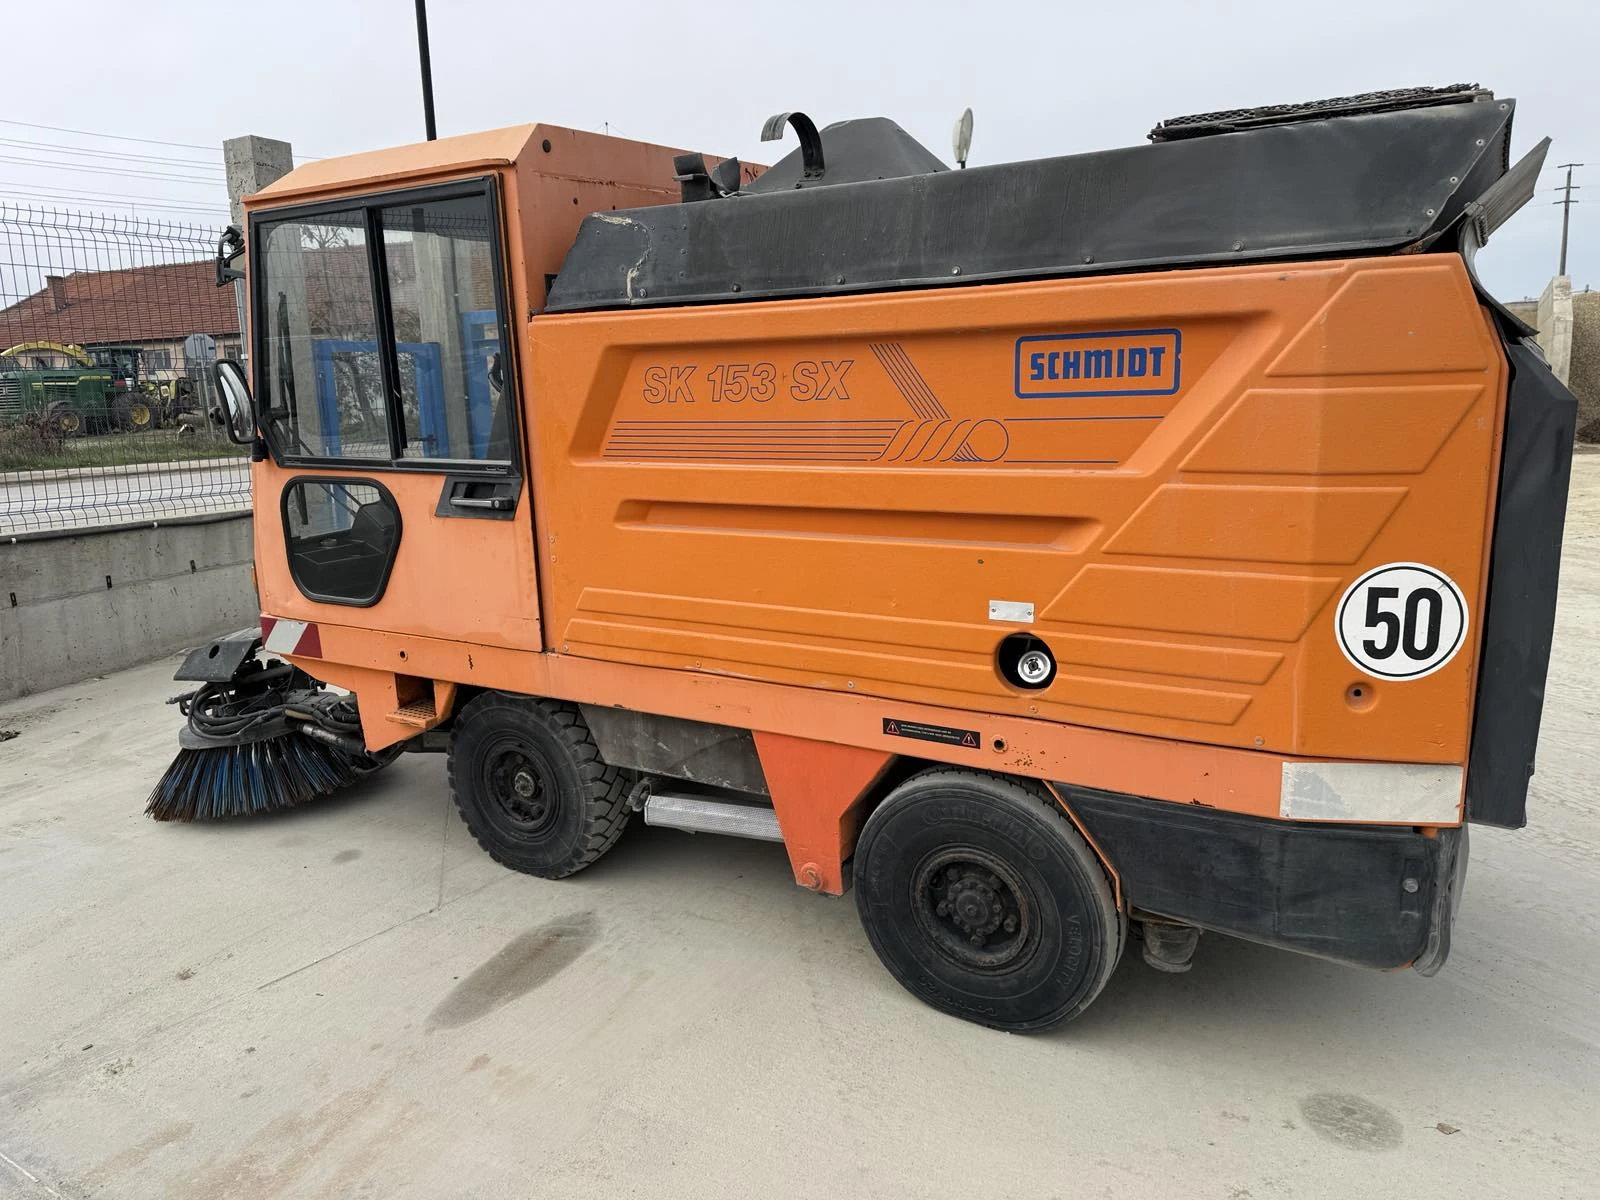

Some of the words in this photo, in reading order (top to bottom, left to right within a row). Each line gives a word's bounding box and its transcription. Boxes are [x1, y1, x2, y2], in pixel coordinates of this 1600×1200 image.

[643, 366, 697, 404] SK
[707, 362, 777, 402] 153
[790, 360, 854, 401] SX
[1030, 347, 1166, 380] SCHMIDT
[1362, 587, 1443, 660] 50
